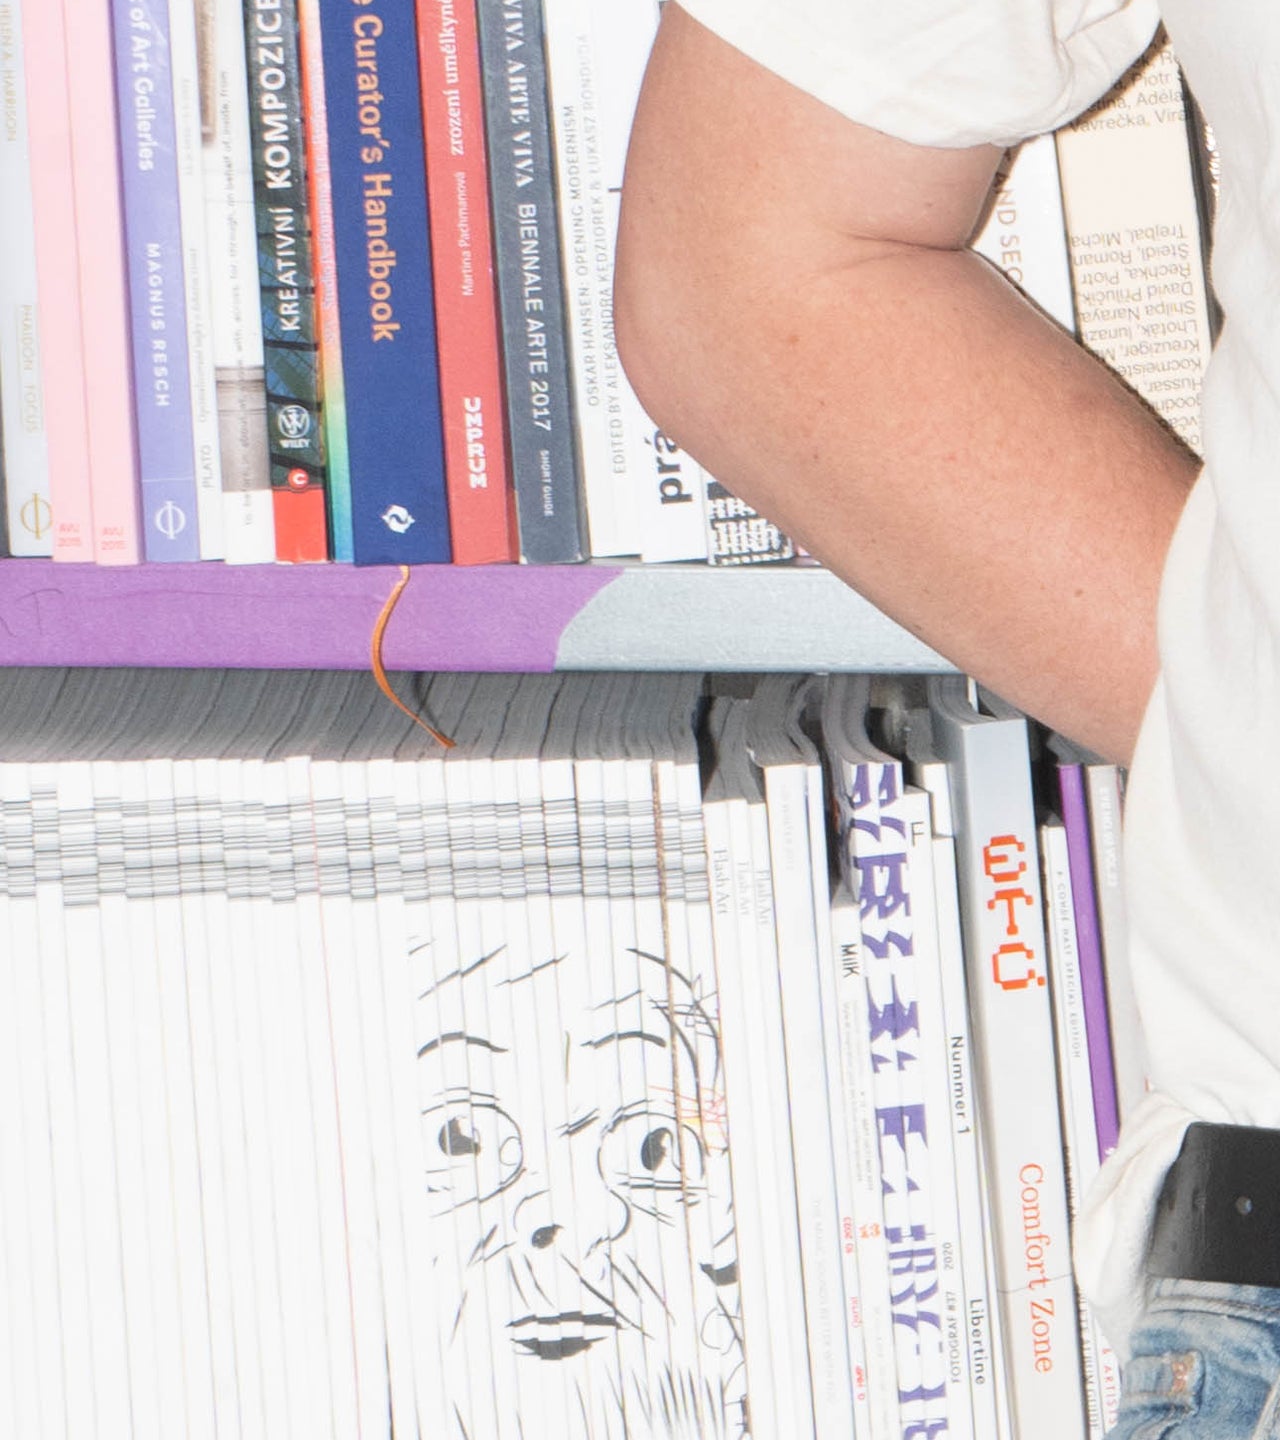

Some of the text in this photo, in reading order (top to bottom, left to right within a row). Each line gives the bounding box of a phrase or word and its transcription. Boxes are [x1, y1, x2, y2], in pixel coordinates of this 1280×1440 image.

[128, 4, 154, 33] of
[131, 36, 153, 73] Art
[133, 76, 160, 171] Galleries
[267, 206, 301, 332] KREATIVNÍ
[363, 173, 401, 342] Handbook
[146, 243, 170, 407] MAGNUS RESCH
[517, 203, 552, 431] BIENNALE ARTE 2017
[463, 396, 488, 489] UMPRUM
[950, 1034, 970, 1120] Nummer
[1018, 1162, 1055, 1373] Comfort Zone
[968, 1296, 987, 1387] Libertine
